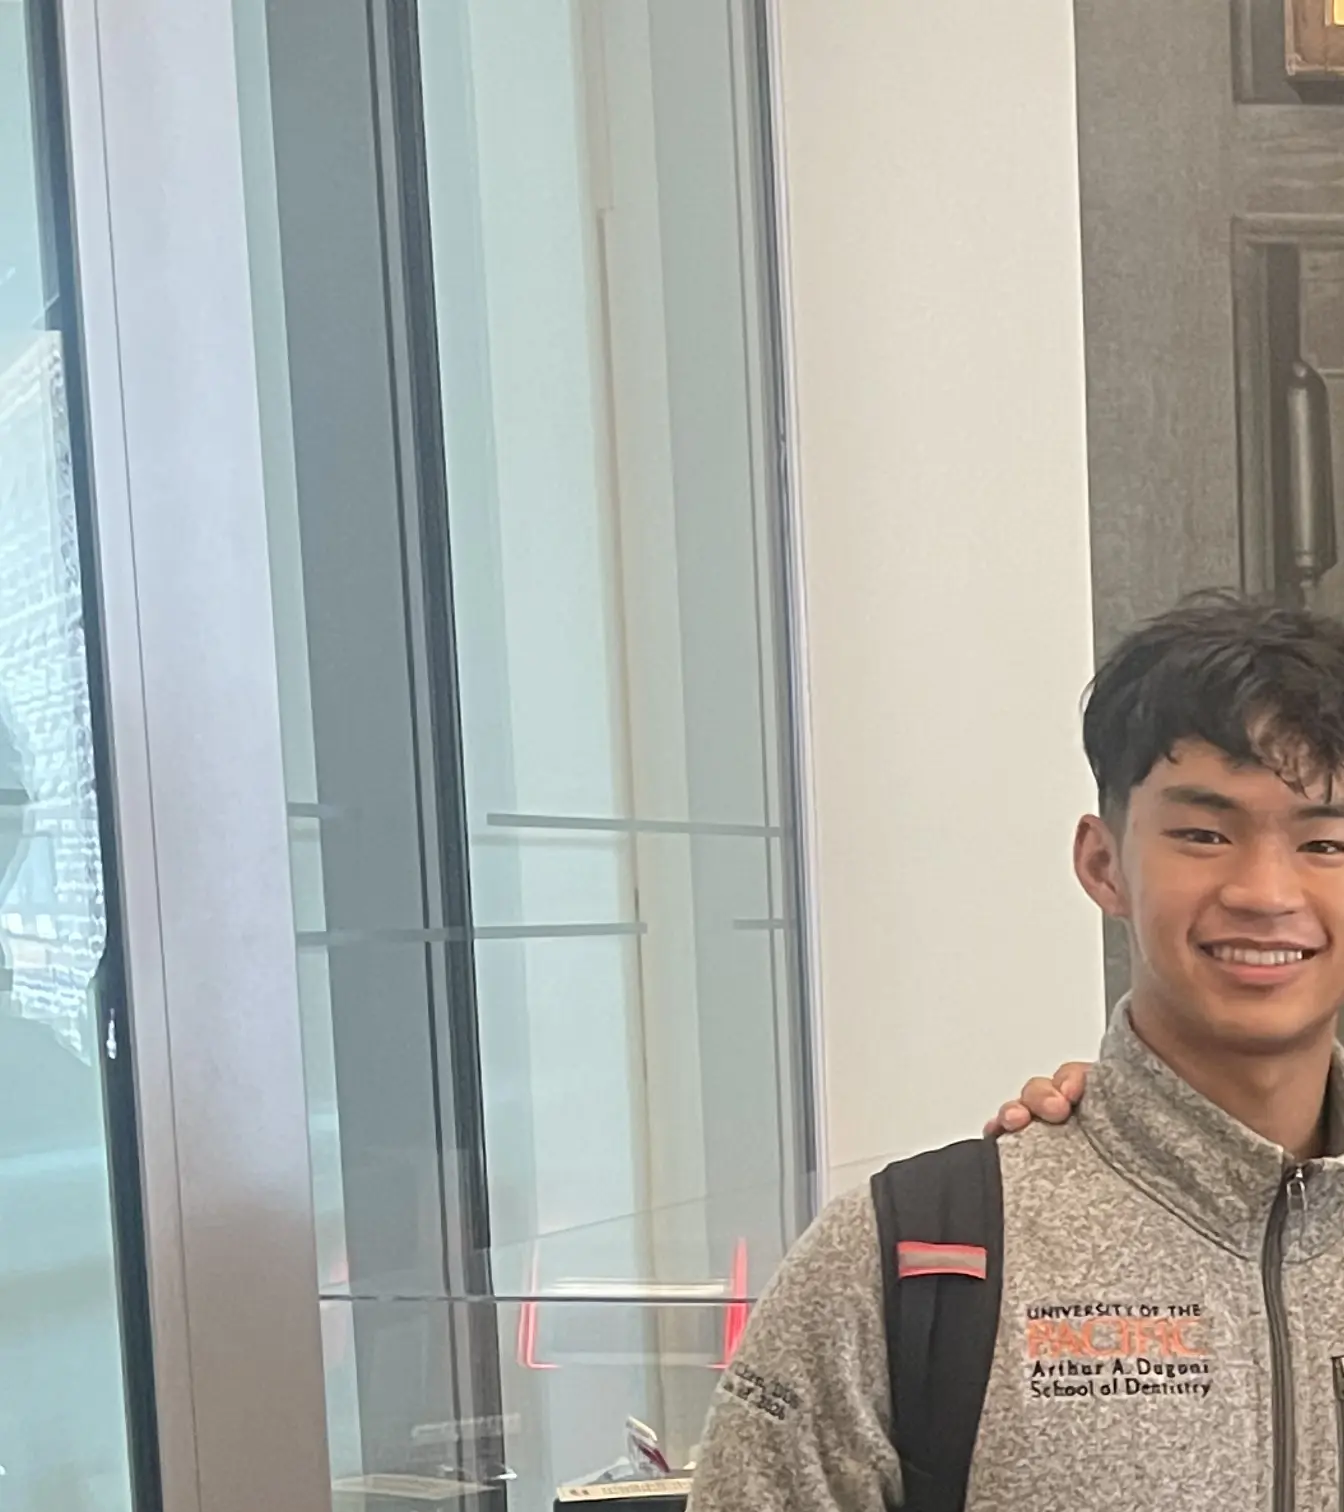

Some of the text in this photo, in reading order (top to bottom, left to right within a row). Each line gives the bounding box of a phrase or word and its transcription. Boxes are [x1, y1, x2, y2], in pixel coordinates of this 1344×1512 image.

[1027, 1302, 1201, 1320] UNIVERSITY OF THE
[1027, 1317, 1209, 1359] PACIFIC
[1031, 1359, 1104, 1377] Arthur
[1136, 1358, 1209, 1378] Dugoni
[1031, 1378, 1213, 1398] School of Dentistry
